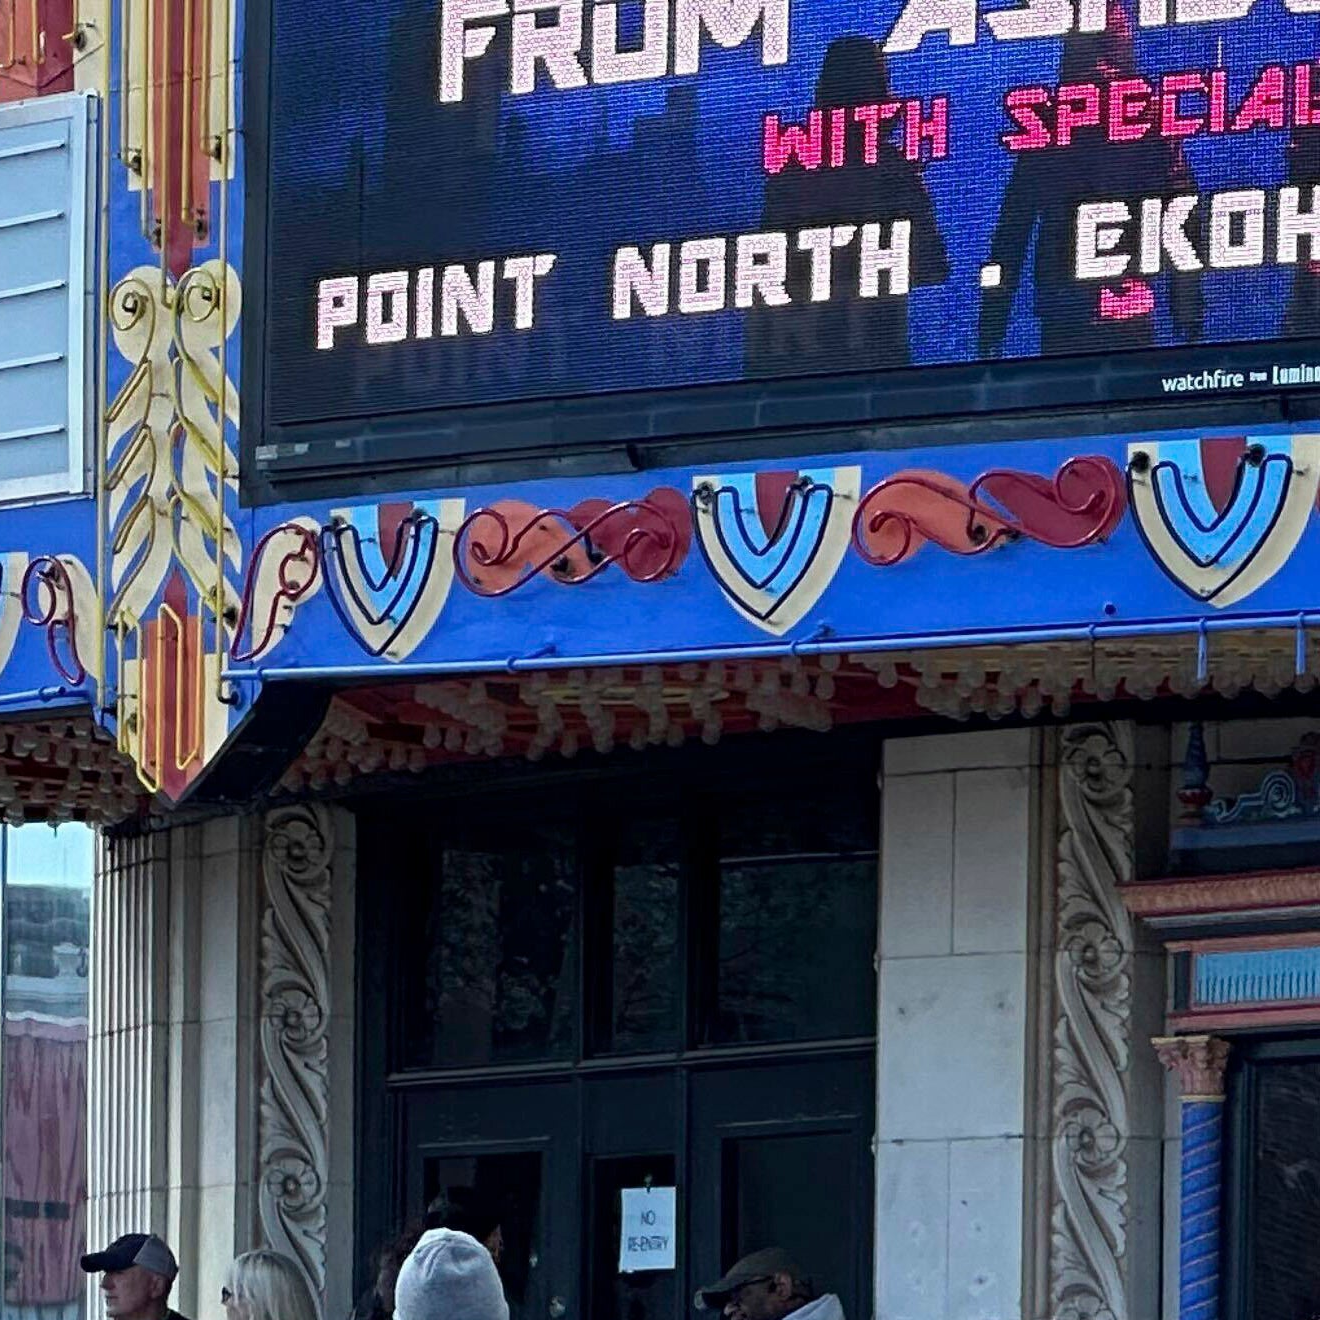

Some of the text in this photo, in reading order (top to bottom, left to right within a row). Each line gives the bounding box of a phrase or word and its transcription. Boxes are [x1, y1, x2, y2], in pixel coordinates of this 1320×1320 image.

[439, 0, 789, 103] FROM
[763, 63, 1320, 175] WITH SPECIAL
[316, 253, 558, 350] POINT
[612, 219, 912, 320] NORTH
[1161, 369, 1245, 392] watchfire
[641, 1209, 656, 1226] NO
